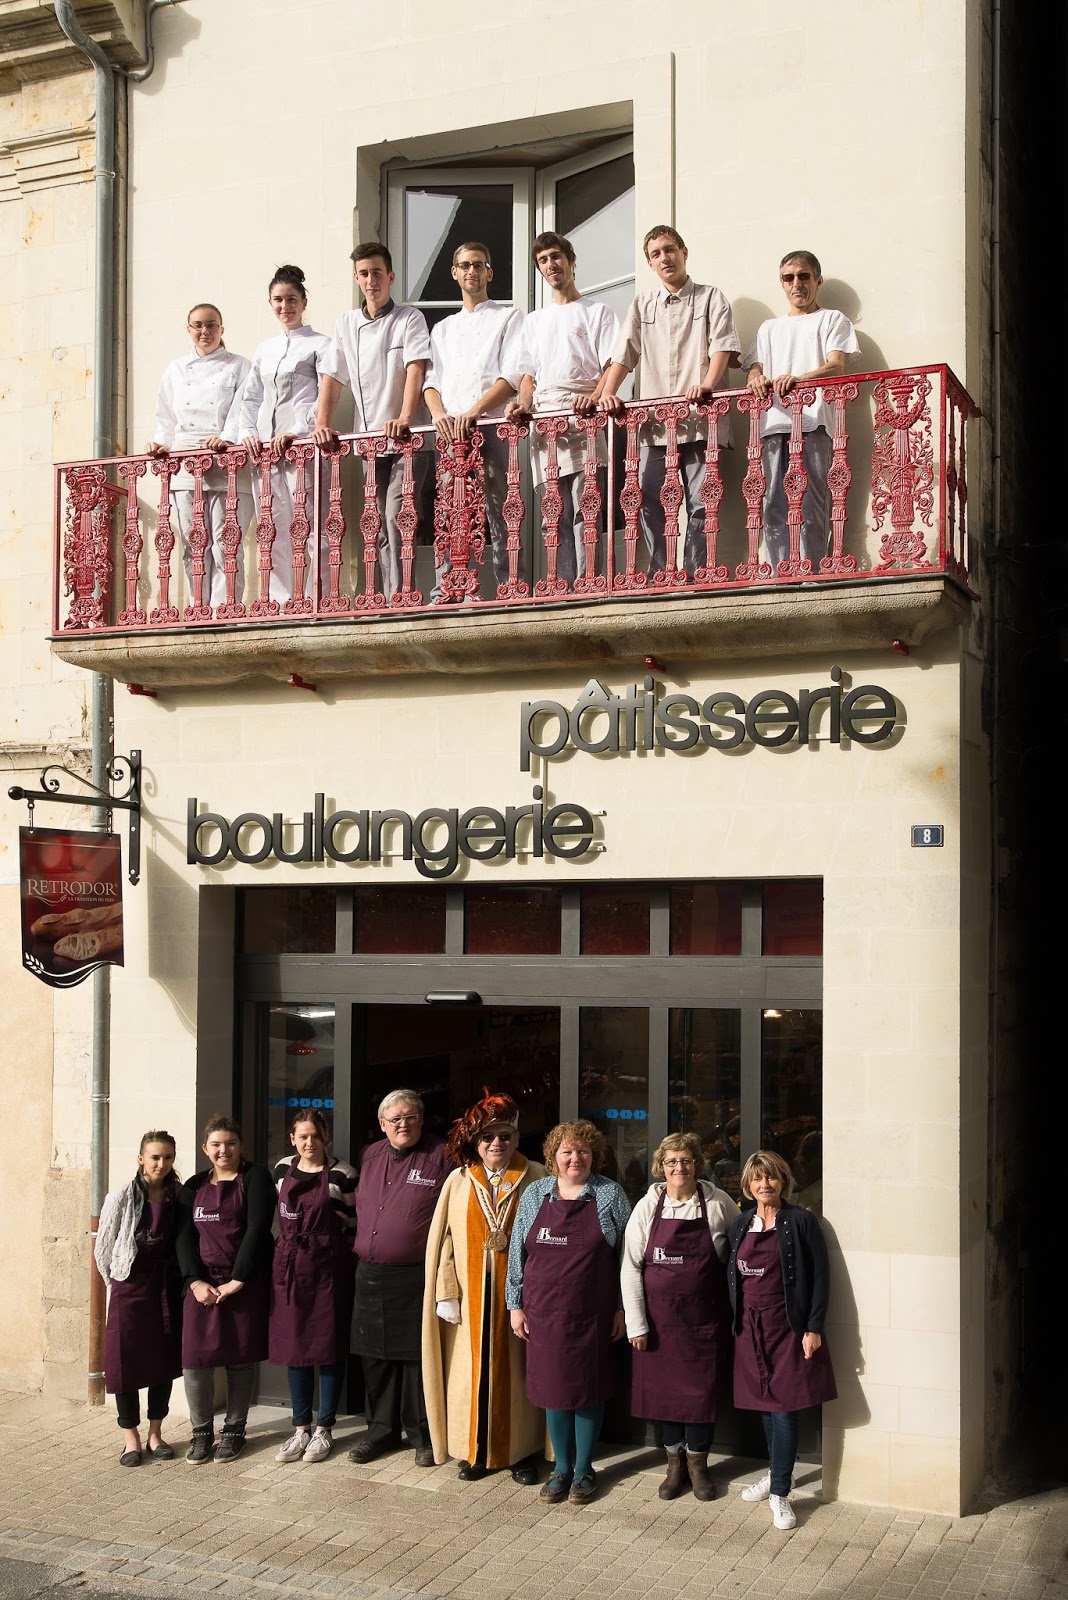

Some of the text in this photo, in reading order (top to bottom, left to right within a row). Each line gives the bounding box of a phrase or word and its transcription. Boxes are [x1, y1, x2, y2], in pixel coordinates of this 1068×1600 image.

[520, 665, 896, 772] pâtisserie
[187, 785, 594, 878] boulangerie
[923, 828, 931, 843] 8
[26, 878, 116, 896] RETRODOR
